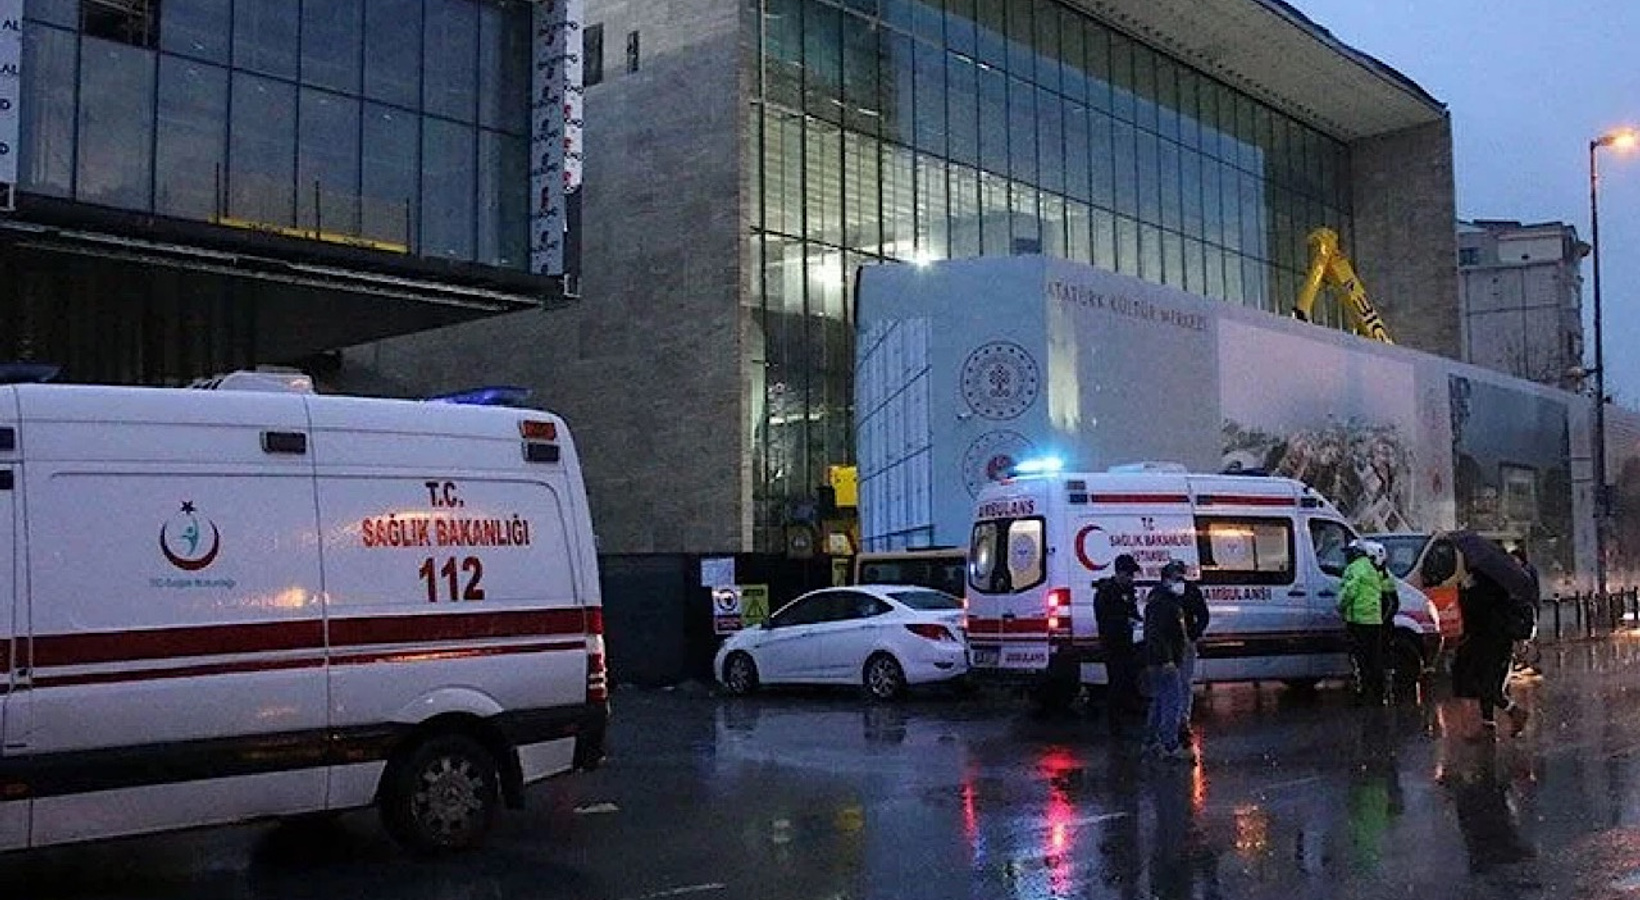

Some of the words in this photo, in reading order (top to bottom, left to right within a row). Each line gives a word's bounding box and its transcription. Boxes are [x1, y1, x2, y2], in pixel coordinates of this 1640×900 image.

[425, 482, 464, 508] T.C.
[362, 513, 431, 547] SAĞLIK
[434, 513, 530, 547] BAKANLIĞI
[418, 556, 486, 603] 112
